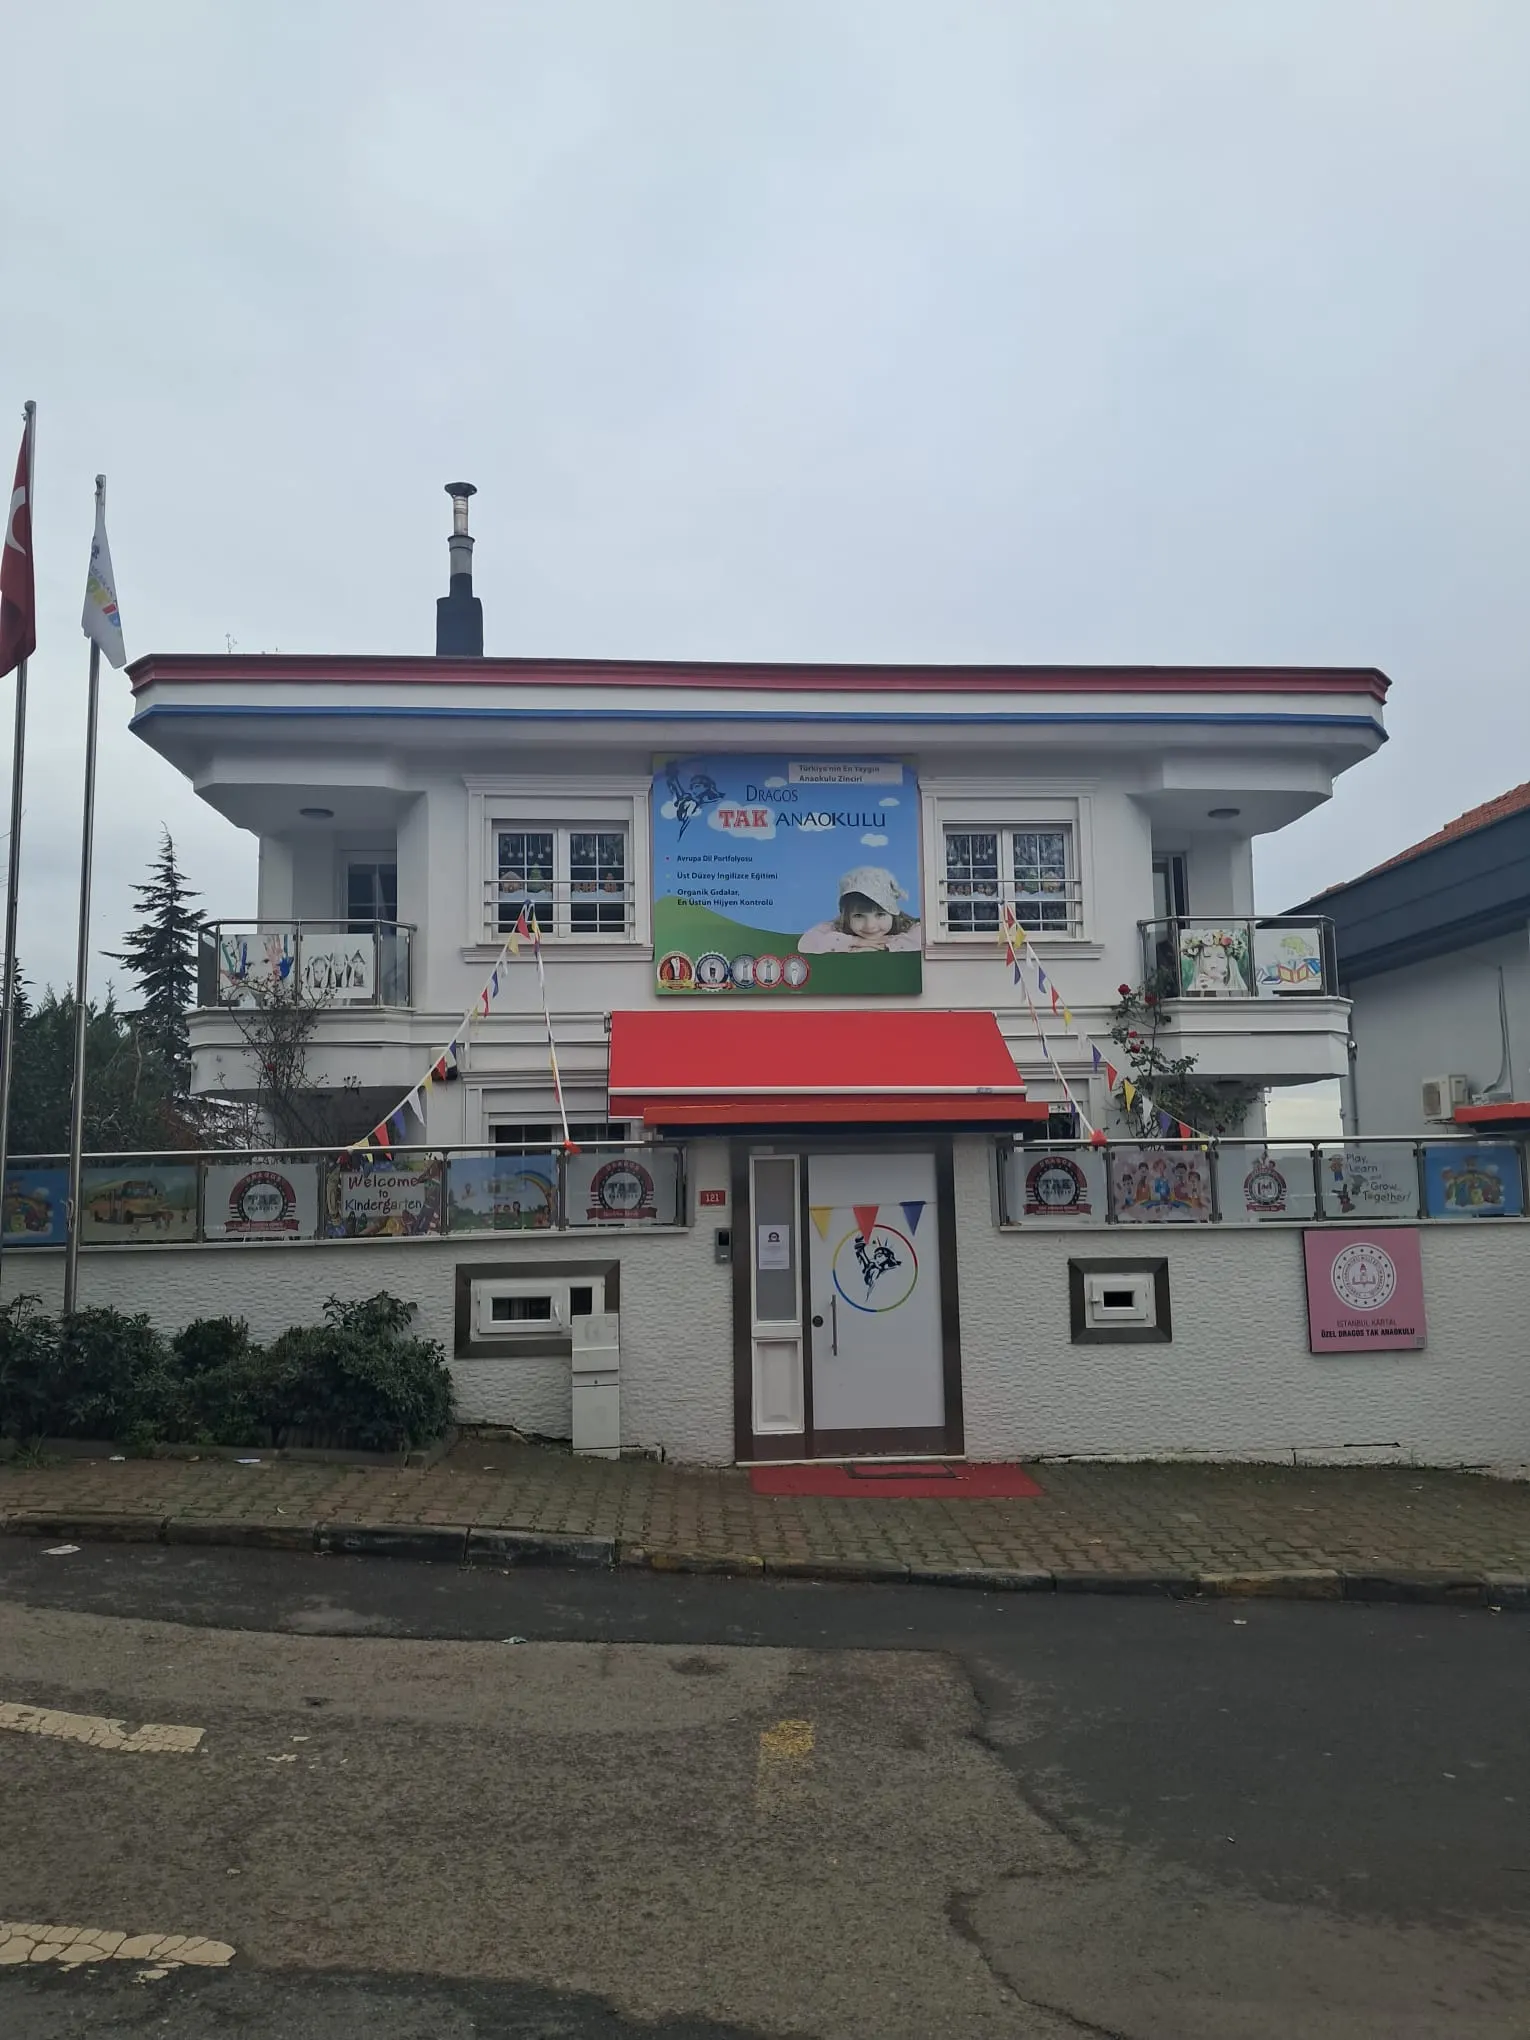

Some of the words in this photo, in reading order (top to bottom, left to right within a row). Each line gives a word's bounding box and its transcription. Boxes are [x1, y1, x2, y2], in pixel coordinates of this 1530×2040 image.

[799, 774, 836, 783] Anaokulu
[838, 775, 863, 783] Zinciri
[719, 809, 768, 828] TAK
[776, 811, 886, 827] ANAOKULU
[677, 855, 701, 863] Avrupa
[714, 855, 753, 863] Portfolyosu
[751, 872, 778, 881] Eğitimi
[677, 889, 708, 897] Organik
[713, 899, 738, 907] Hijyen
[348, 1174, 418, 1190] Welcome
[379, 1190, 388, 1198] to
[706, 1193, 719, 1202] 121
[1321, 1329, 1336, 1338] ÖZEL
[1338, 1329, 1364, 1338] DRAGOS
[1366, 1329, 1379, 1337] TAK
[1380, 1328, 1415, 1336] ANAOKULU
